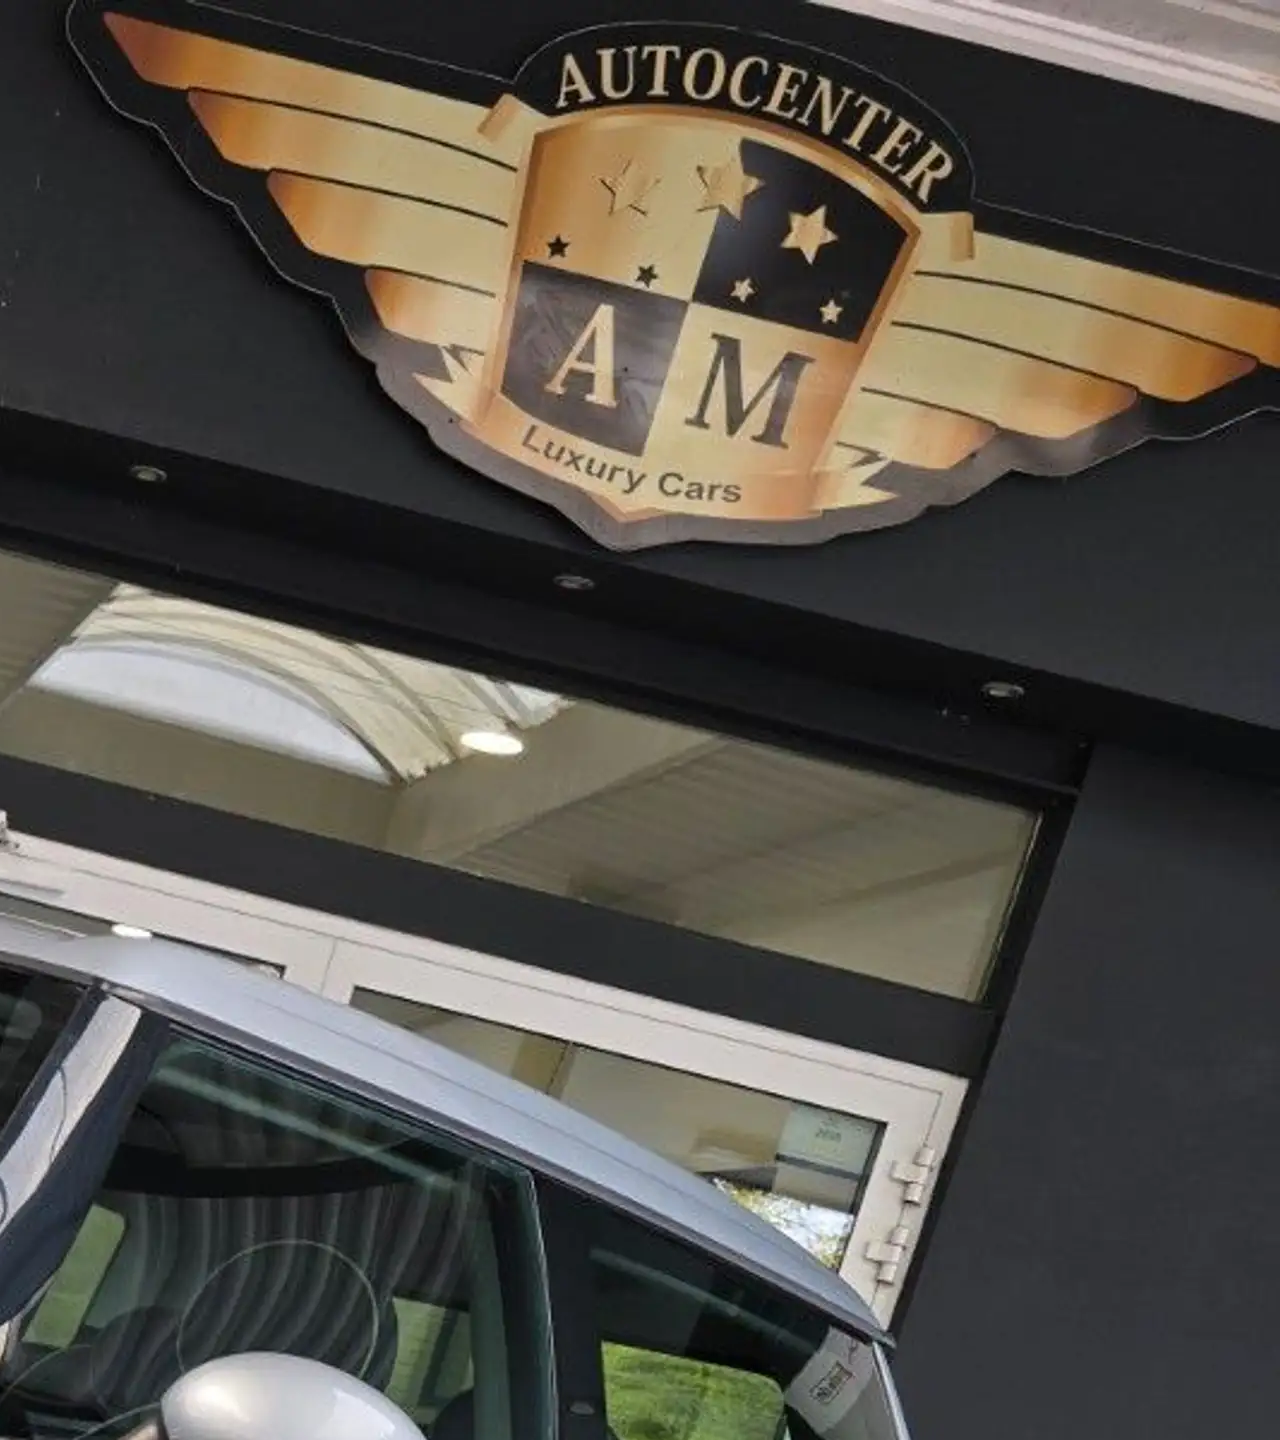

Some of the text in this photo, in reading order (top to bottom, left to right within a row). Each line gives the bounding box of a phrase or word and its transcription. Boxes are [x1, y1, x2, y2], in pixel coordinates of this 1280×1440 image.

[555, 45, 954, 204] AUTOCENTER
[545, 303, 816, 450] A M
[521, 424, 742, 503] Luxury Cars
